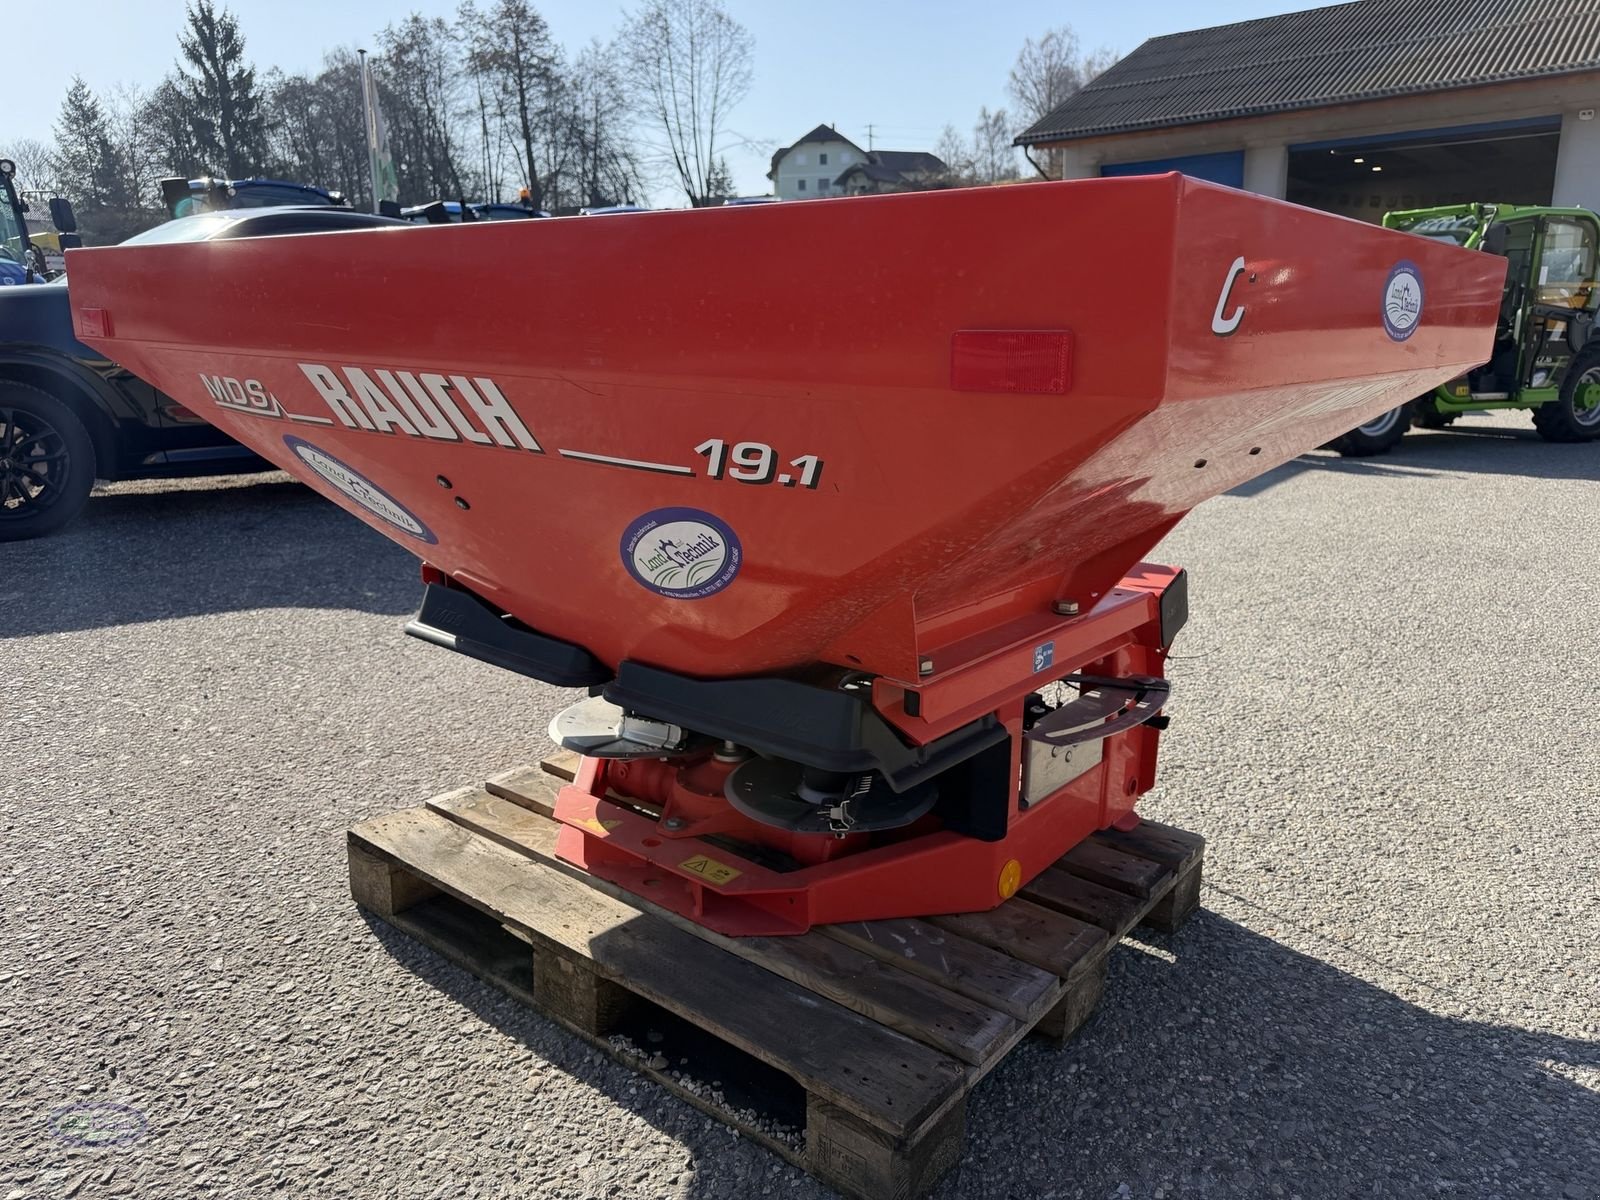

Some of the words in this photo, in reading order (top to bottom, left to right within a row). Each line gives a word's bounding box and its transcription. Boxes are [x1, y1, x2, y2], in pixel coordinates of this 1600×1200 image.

[200, 374, 270, 409] MDS
[298, 363, 545, 453] RAUCH
[694, 438, 824, 490] 19.1
[311, 453, 346, 481] Land
[358, 489, 416, 531] Technik
[638, 548, 669, 572] Land
[674, 533, 720, 565] Technik
